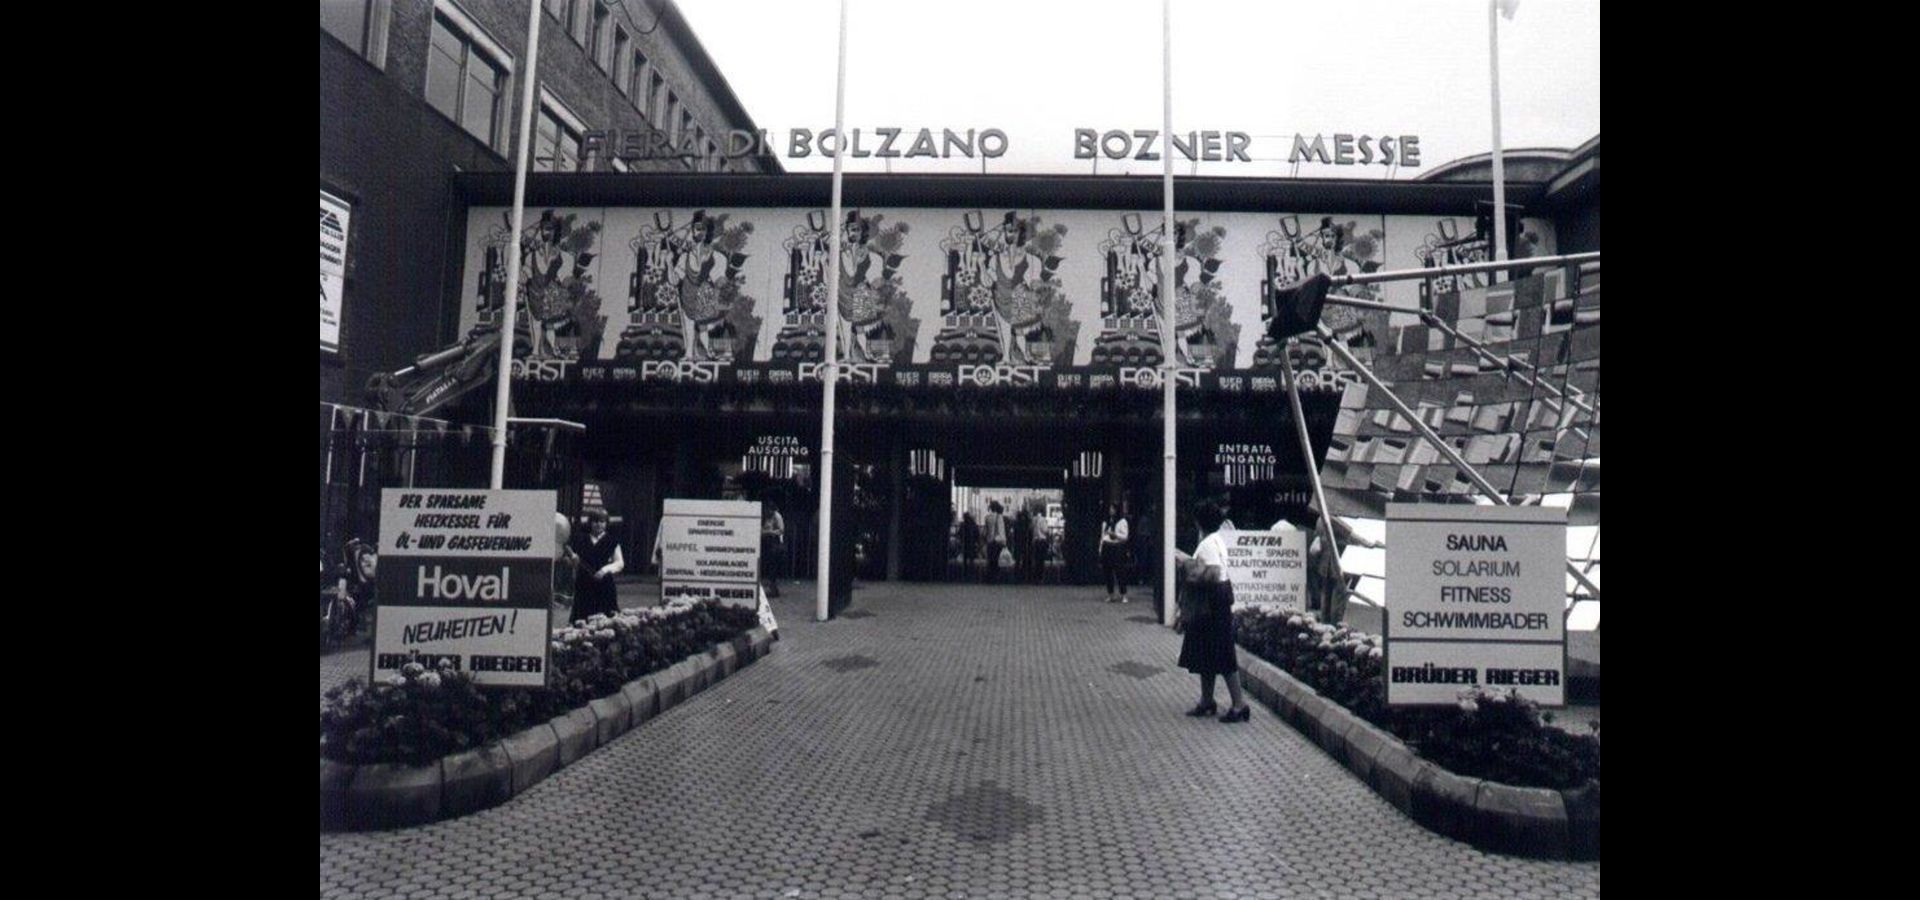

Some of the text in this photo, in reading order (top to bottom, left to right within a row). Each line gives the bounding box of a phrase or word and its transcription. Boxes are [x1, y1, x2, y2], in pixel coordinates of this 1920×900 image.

[578, 127, 1421, 167] FIERA DI BOLZANO BOZNER MESSE
[511, 359, 577, 382] ORST
[641, 360, 731, 383] FORST
[958, 364, 1054, 388] FORST
[758, 436, 799, 446] USCITA
[1219, 444, 1272, 454] ENTRATA
[748, 446, 809, 456] AUSGANG
[1215, 454, 1277, 465] EINGANG
[399, 494, 487, 510] DER SPARSAME
[414, 512, 512, 529] HEIZKESSEL FÜR
[418, 535, 446, 549] UND
[447, 535, 532, 551] GASFEUERUNG
[1237, 536, 1282, 546] CENTRA
[1446, 534, 1507, 551] SAUNA
[1266, 549, 1298, 557] SPAREN
[1252, 571, 1267, 579] MIT
[1433, 560, 1520, 577] SOLARIUM
[417, 565, 509, 600] Hoval
[1441, 586, 1511, 604] FITNESS
[402, 615, 506, 645] NEUHEITEN
[470, 655, 542, 672] RIEGER
[1392, 662, 1560, 685] BRÜDER RIEGER
